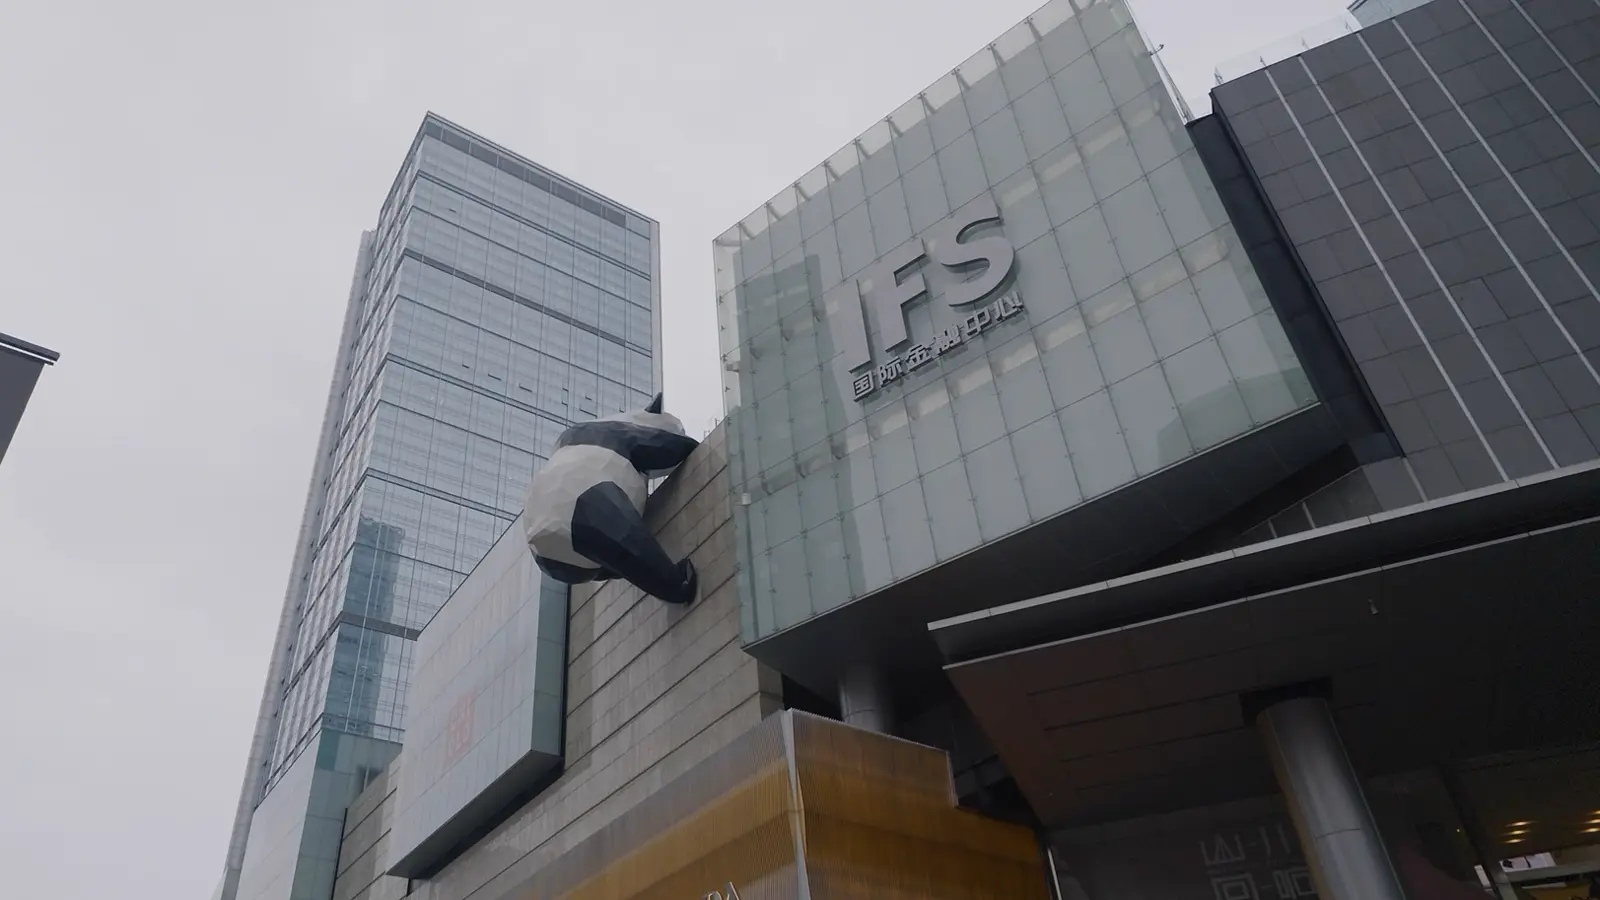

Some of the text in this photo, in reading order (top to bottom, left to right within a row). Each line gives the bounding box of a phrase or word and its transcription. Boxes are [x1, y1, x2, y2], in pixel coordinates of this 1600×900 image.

[832, 204, 1016, 373] IFS
[851, 291, 1025, 402] 国际金融中心
